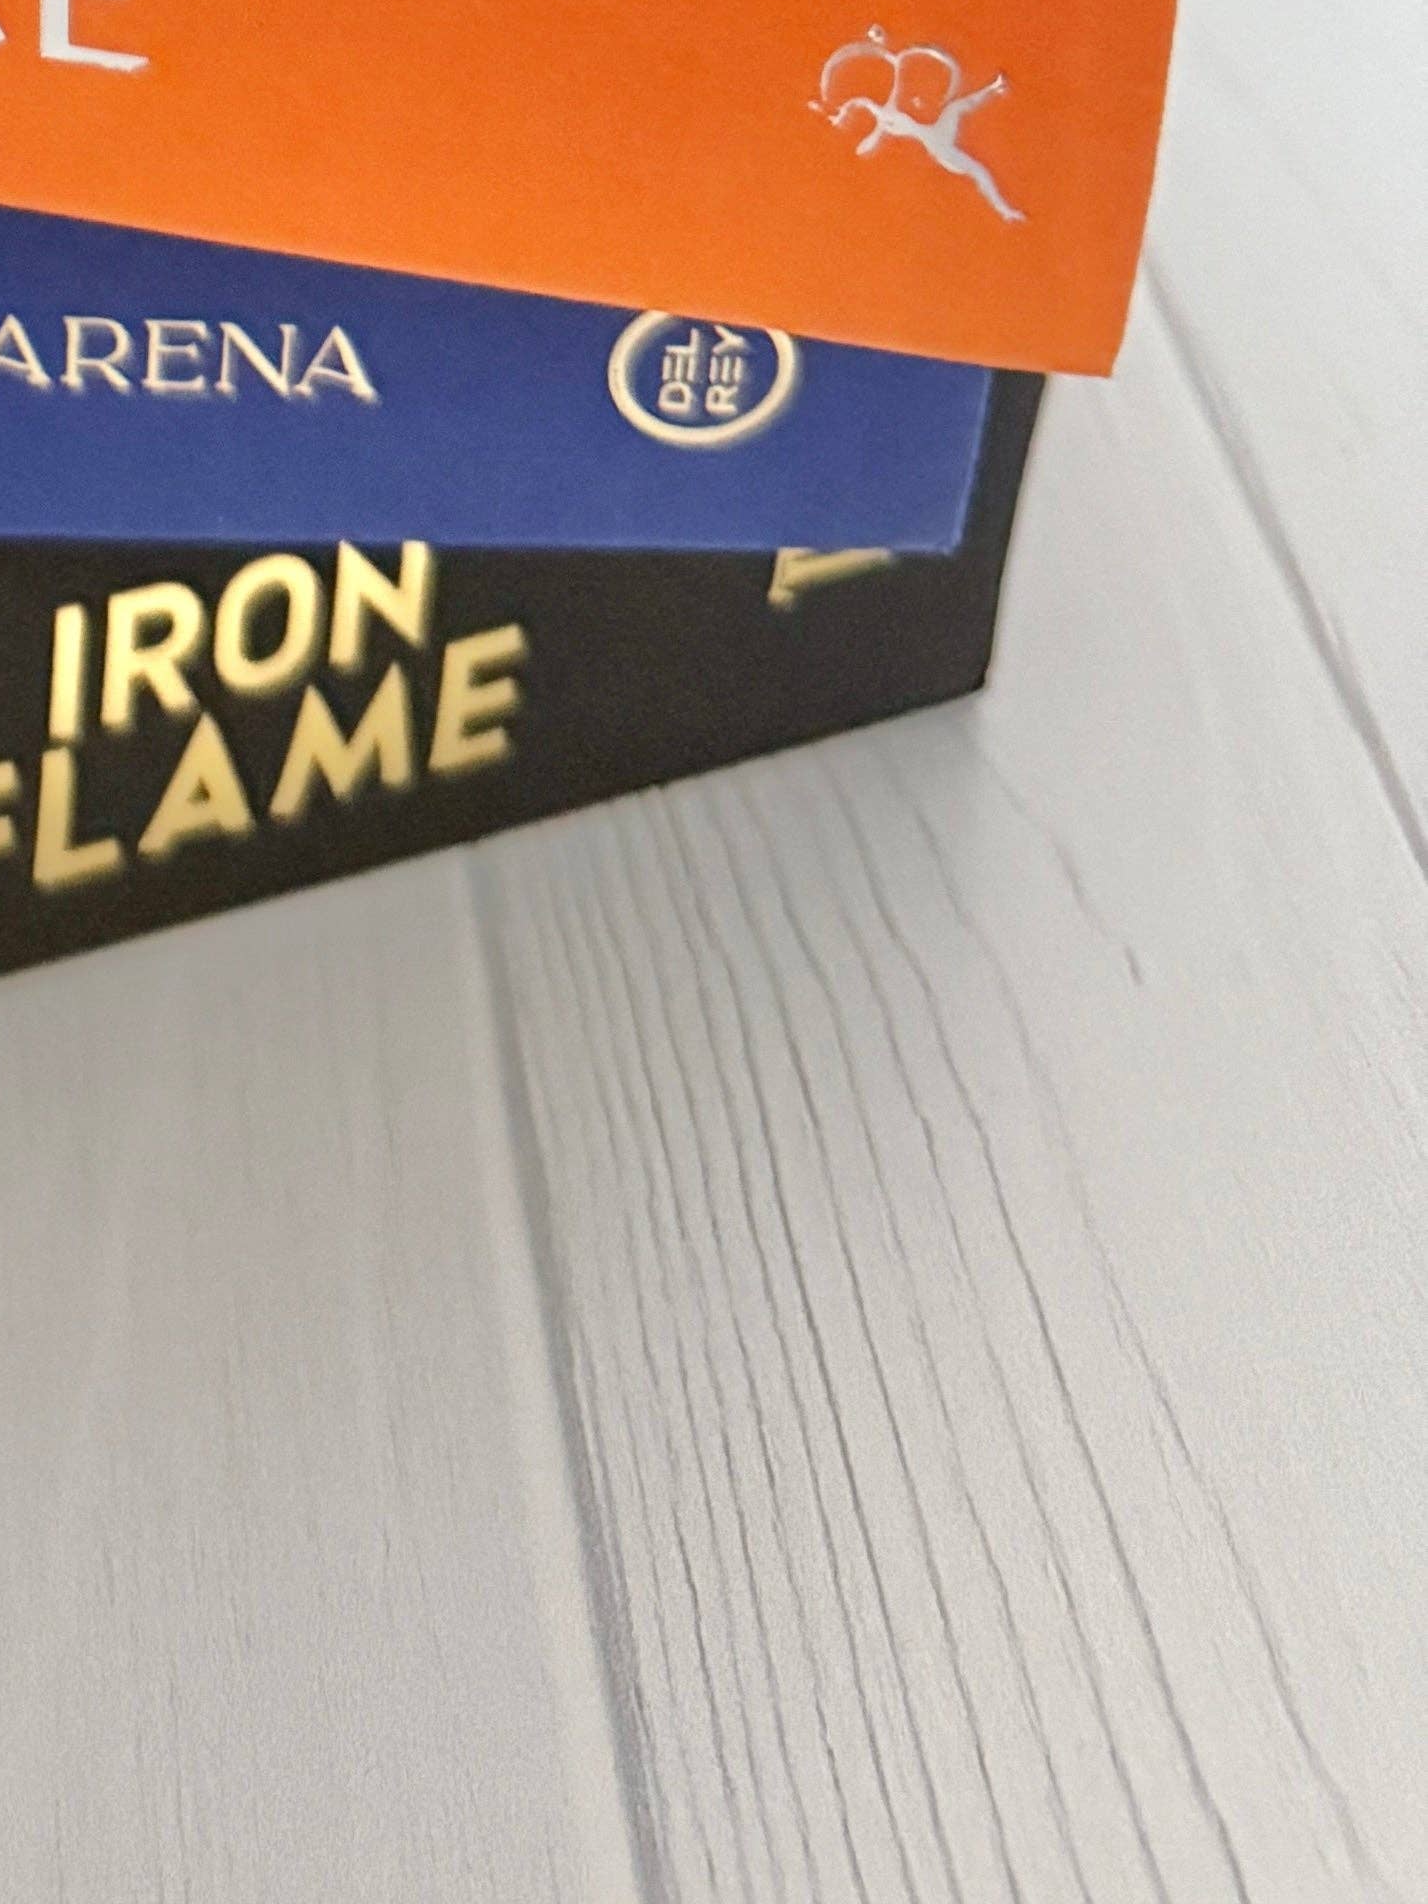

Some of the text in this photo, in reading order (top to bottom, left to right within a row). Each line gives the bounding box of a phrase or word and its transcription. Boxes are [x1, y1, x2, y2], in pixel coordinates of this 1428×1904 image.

[659, 328, 700, 414] DEL
[706, 326, 750, 416] REY
[48, 541, 430, 741] IRON
